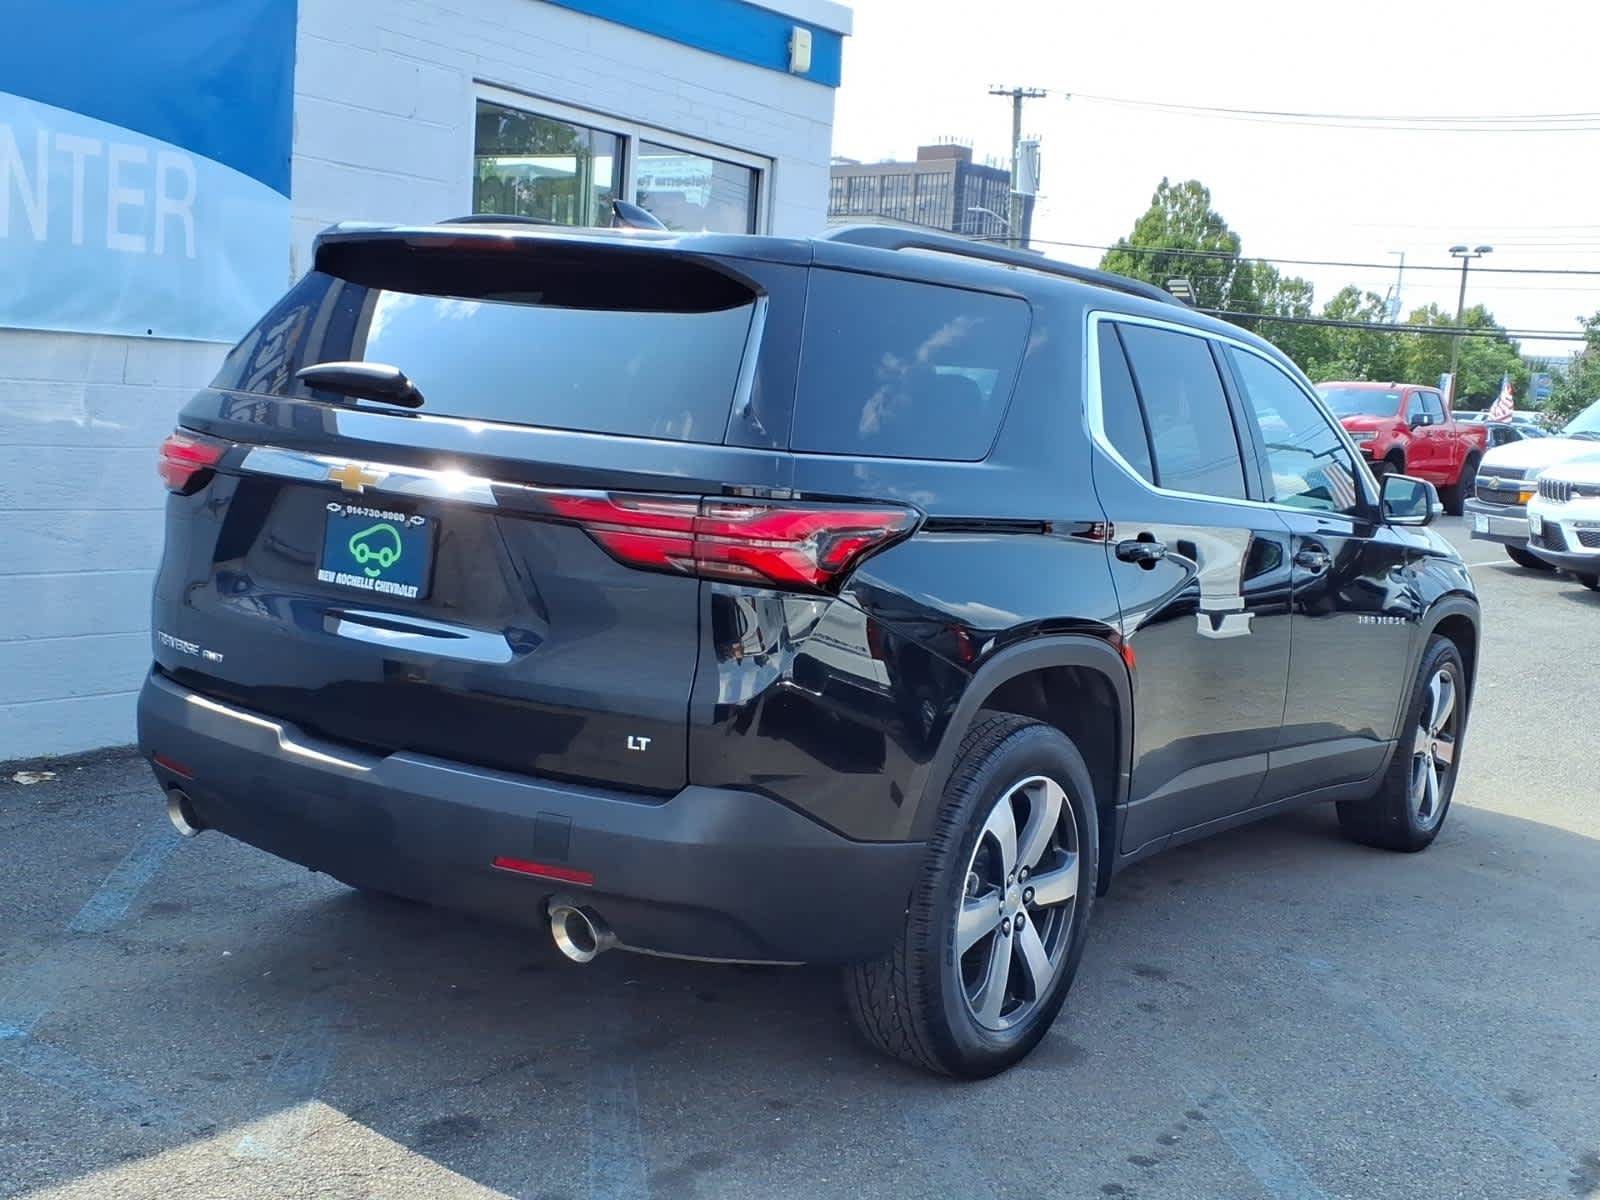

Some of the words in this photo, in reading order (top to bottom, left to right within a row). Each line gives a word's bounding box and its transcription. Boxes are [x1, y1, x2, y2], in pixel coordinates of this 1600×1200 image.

[0, 122, 197, 259] NTER
[318, 569, 336, 583] NEW
[335, 573, 375, 590] ROCHELLE
[375, 580, 418, 598] CHEVROLET
[627, 735, 651, 751] LT
